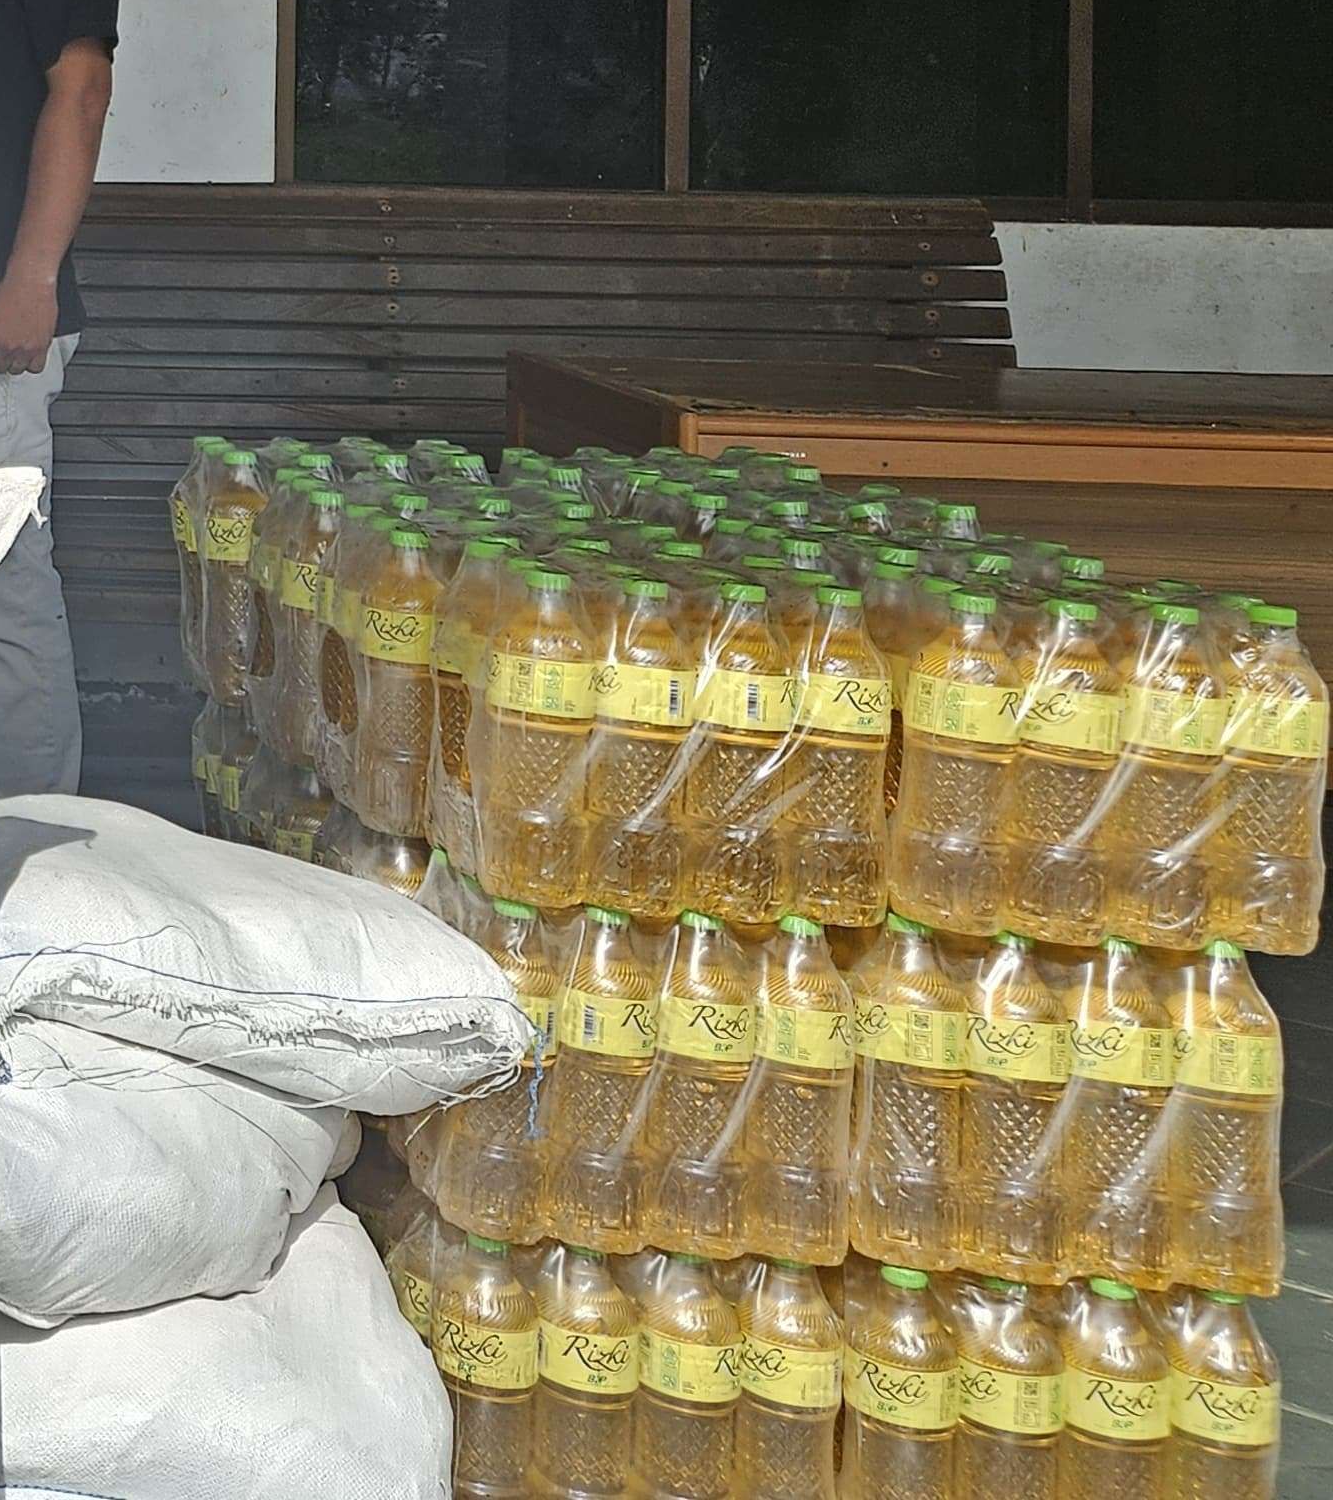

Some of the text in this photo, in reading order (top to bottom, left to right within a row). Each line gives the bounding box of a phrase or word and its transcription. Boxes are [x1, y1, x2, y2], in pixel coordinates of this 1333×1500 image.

[366, 609, 421, 643] Rizki
[966, 1016, 1038, 1056] Rizki
[561, 1333, 632, 1374] Rizki
[856, 1359, 930, 1407] Rizki
[1085, 1378, 1158, 1419] Rizki
[1184, 1379, 1258, 1421] Rizki
